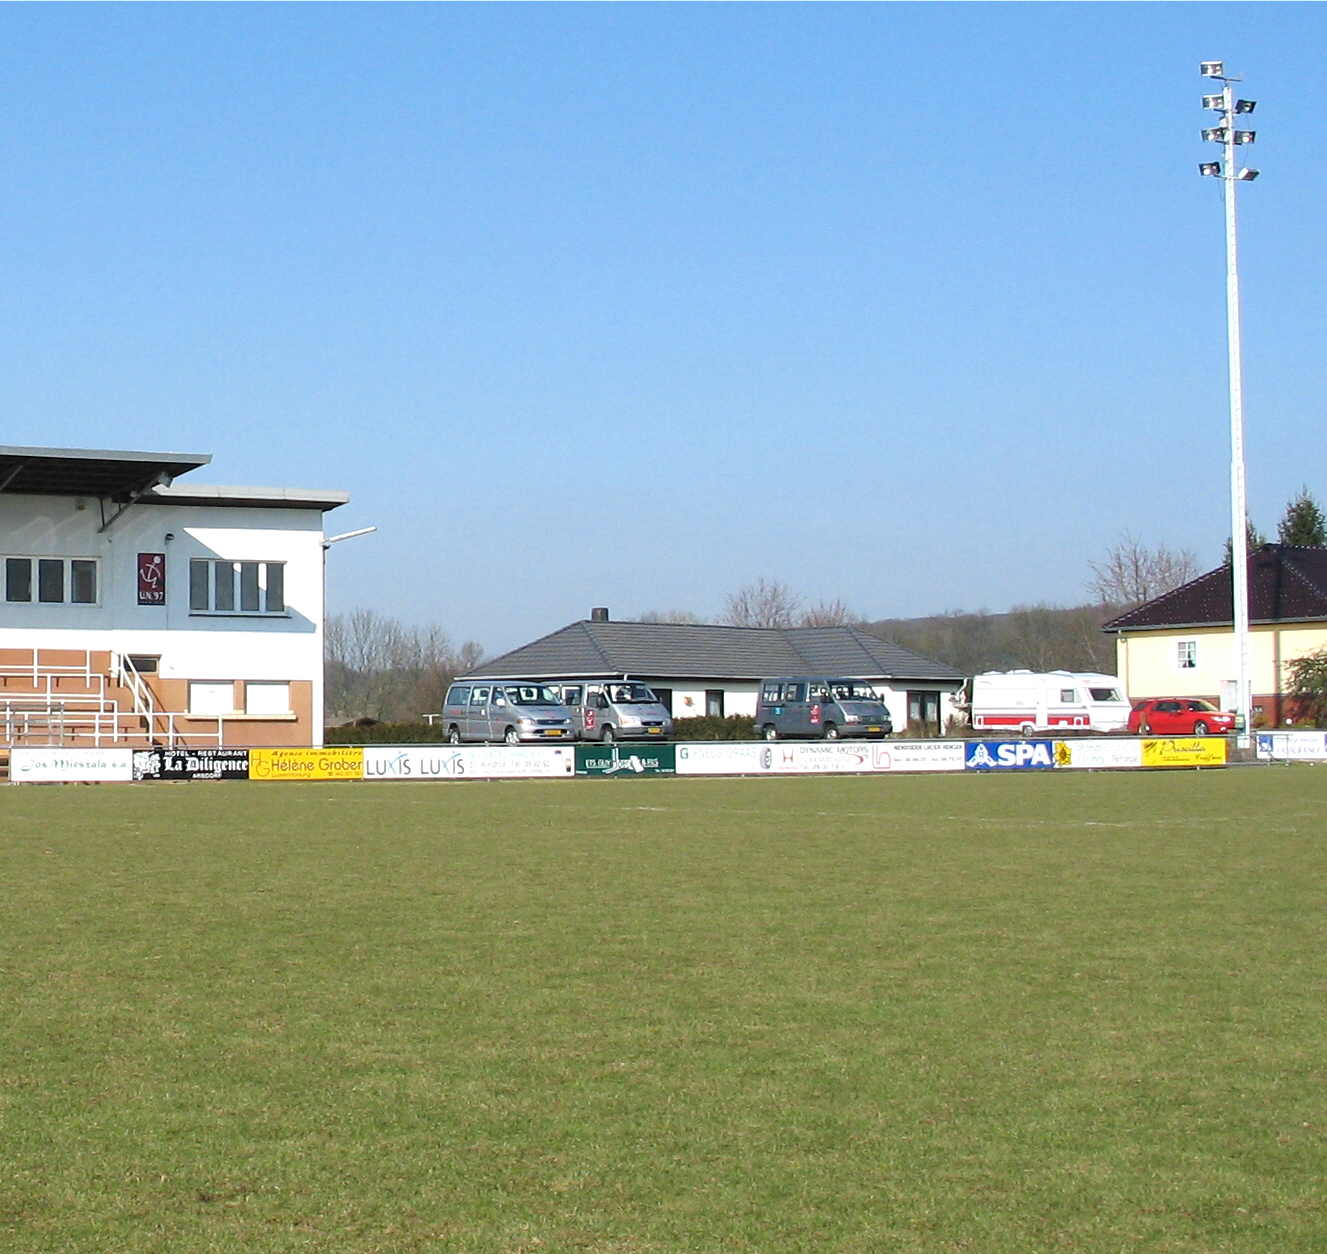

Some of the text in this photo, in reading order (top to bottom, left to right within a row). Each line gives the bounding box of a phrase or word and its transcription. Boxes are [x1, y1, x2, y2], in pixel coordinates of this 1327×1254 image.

[997, 744, 1050, 766] SPA
[163, 757, 249, 773] La Diligence
[272, 759, 315, 771] Hélène
